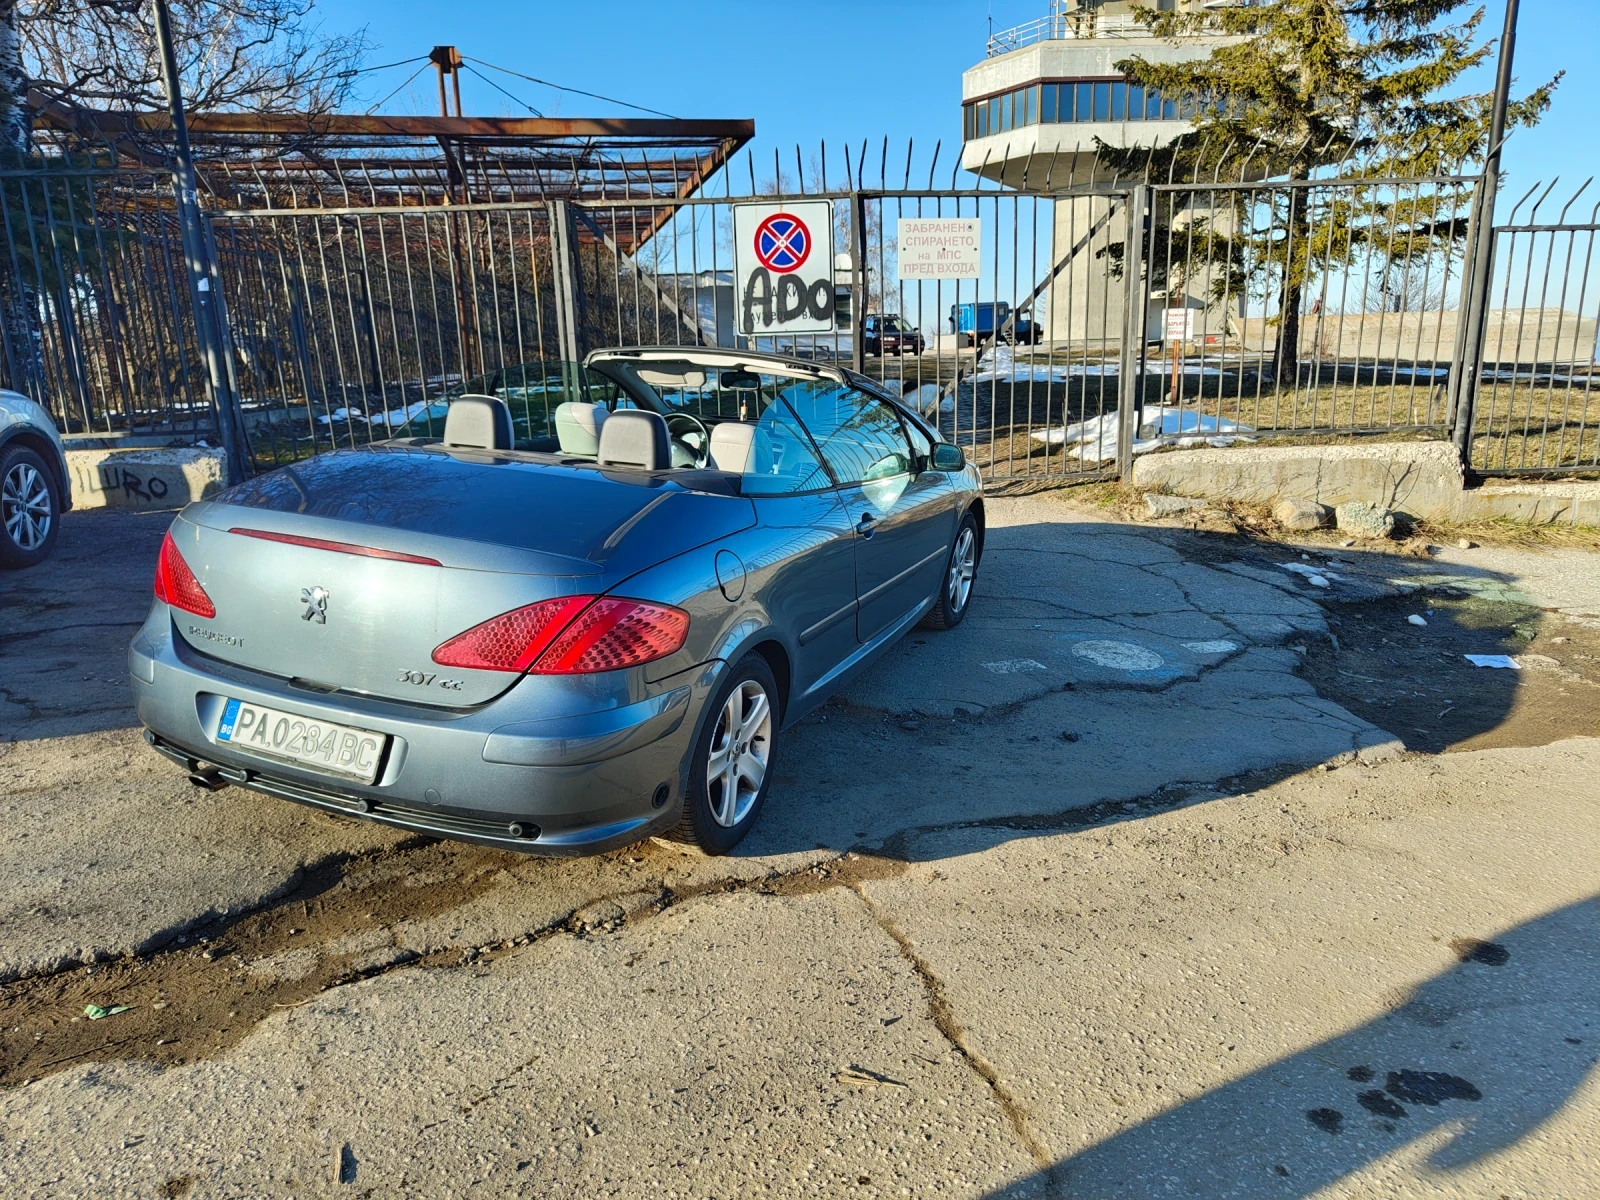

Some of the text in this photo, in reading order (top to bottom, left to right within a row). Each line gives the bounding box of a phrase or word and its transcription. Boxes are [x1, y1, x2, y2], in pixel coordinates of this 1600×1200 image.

[905, 236, 974, 247] СПИРАНЕТО
[918, 250, 962, 261] на МПС
[904, 263, 976, 275] ПРЕД ВХОДА
[395, 668, 437, 686] 307
[220, 723, 233, 735] BG
